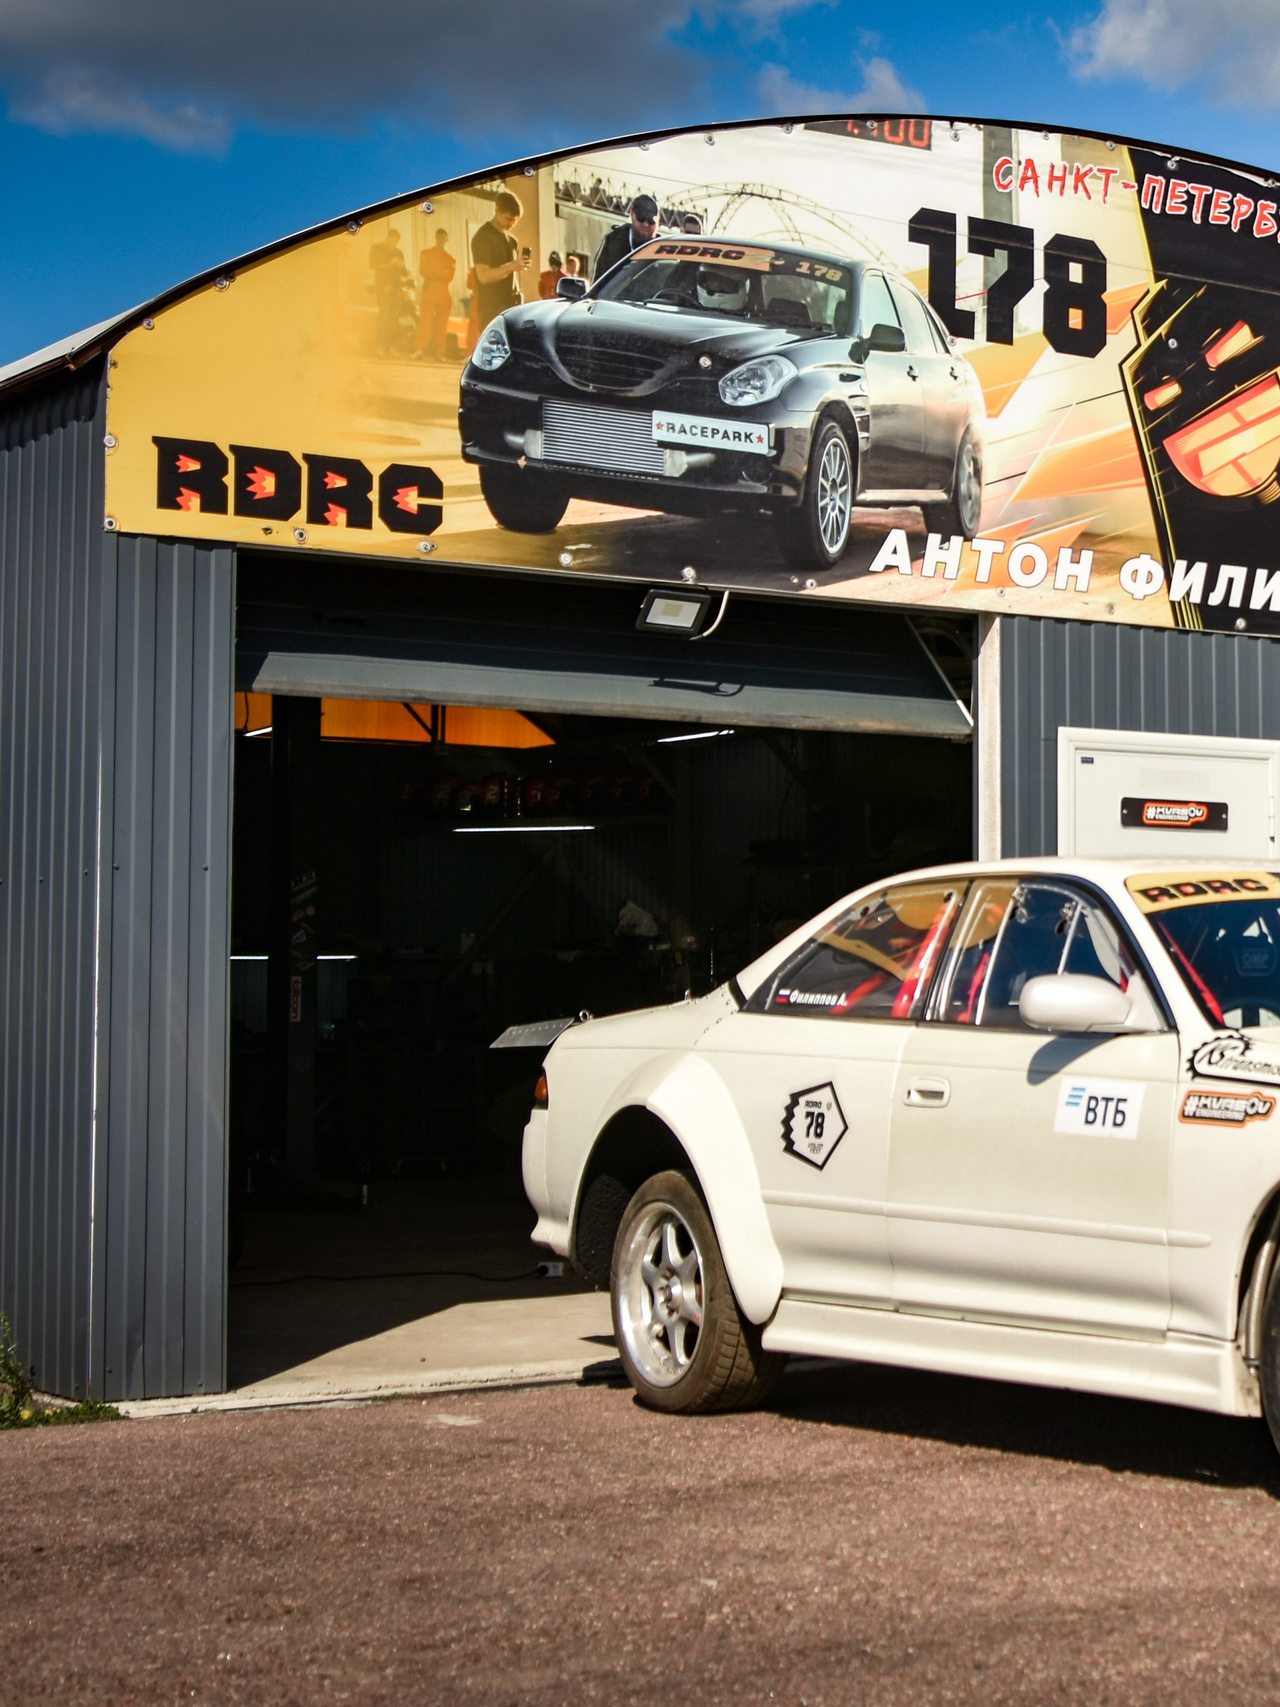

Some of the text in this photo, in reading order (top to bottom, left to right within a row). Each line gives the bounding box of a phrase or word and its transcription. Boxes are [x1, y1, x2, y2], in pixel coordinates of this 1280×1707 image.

[654, 244, 746, 261] RDRC
[795, 260, 844, 282] 178
[908, 207, 1108, 358] 178
[666, 421, 755, 444] RACEPARK
[152, 436, 444, 536] RDRC
[868, 528, 1094, 593] АНТОН
[1134, 879, 1268, 903] RDRC
[789, 988, 848, 1007] Филиппов А.
[804, 1110, 826, 1139] 78
[1084, 1095, 1128, 1128] ВТБ
